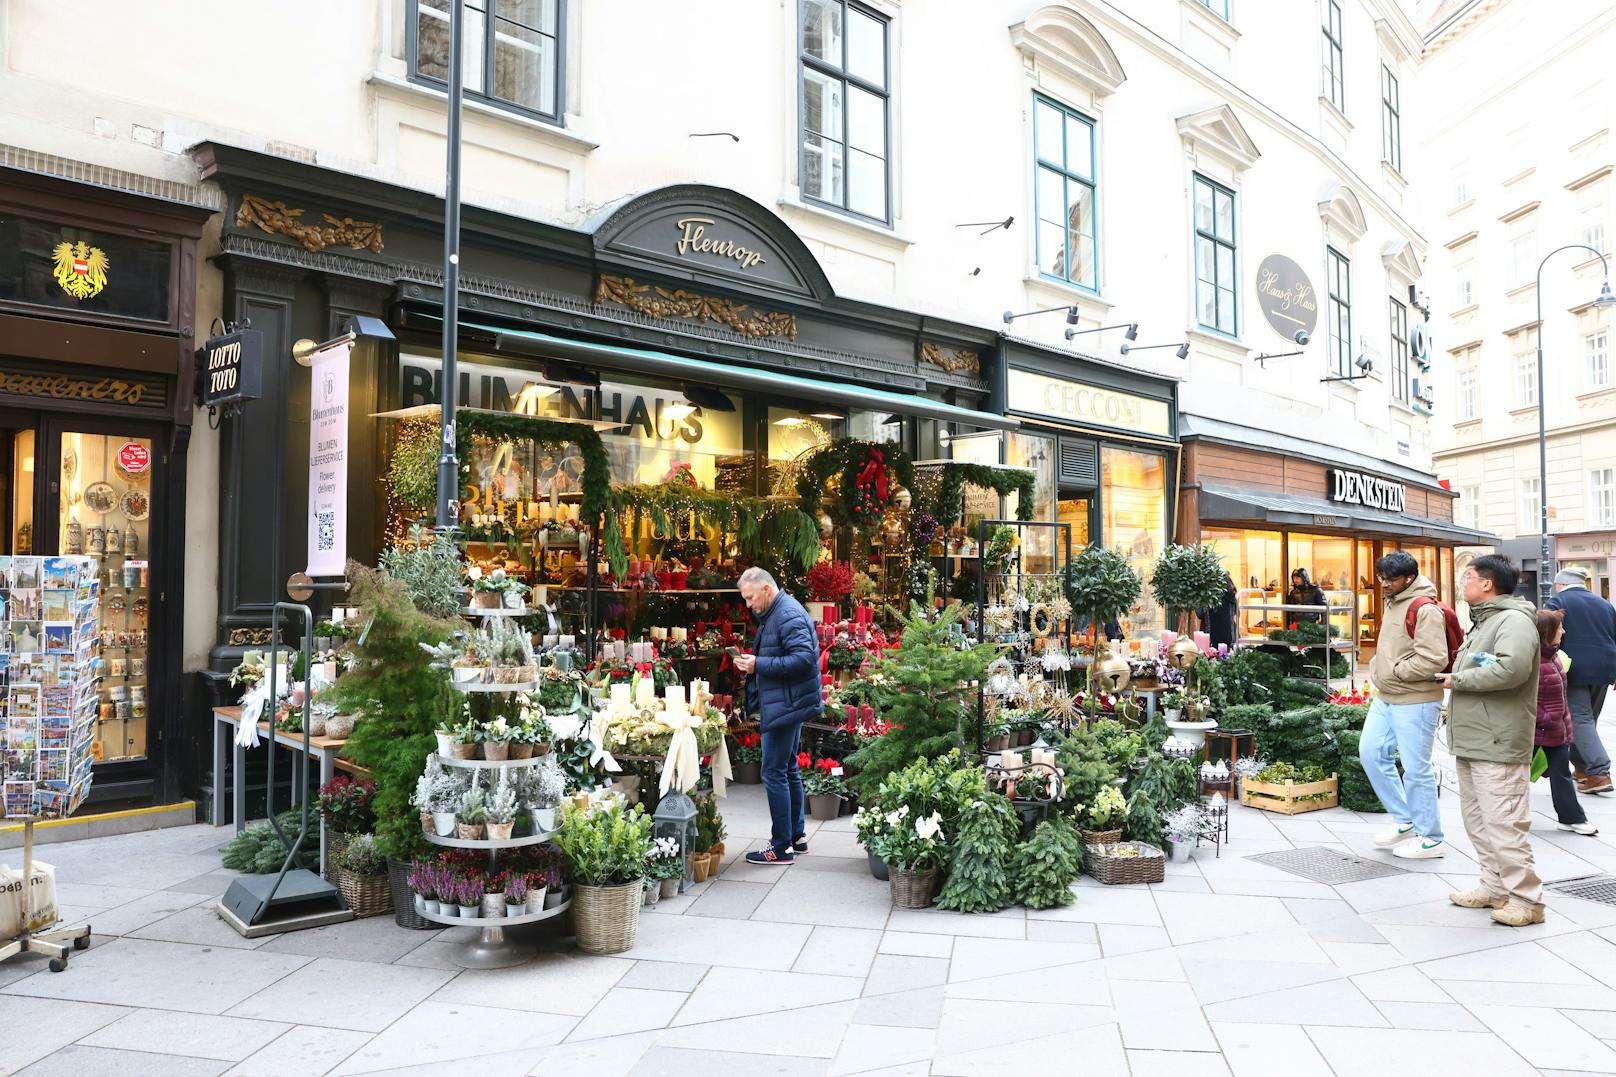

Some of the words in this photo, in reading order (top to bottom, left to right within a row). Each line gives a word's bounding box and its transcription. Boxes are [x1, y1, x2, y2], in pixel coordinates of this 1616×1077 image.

[678, 218, 767, 268] Fleurop
[1259, 268, 1284, 299] Haas
[1293, 282, 1316, 311] Haas
[208, 341, 242, 370] LOTTO
[210, 367, 237, 393] TOTO
[317, 439, 338, 452] BLUMEN
[319, 472, 336, 481] Flower
[1333, 469, 1406, 513] DENKSTEIN
